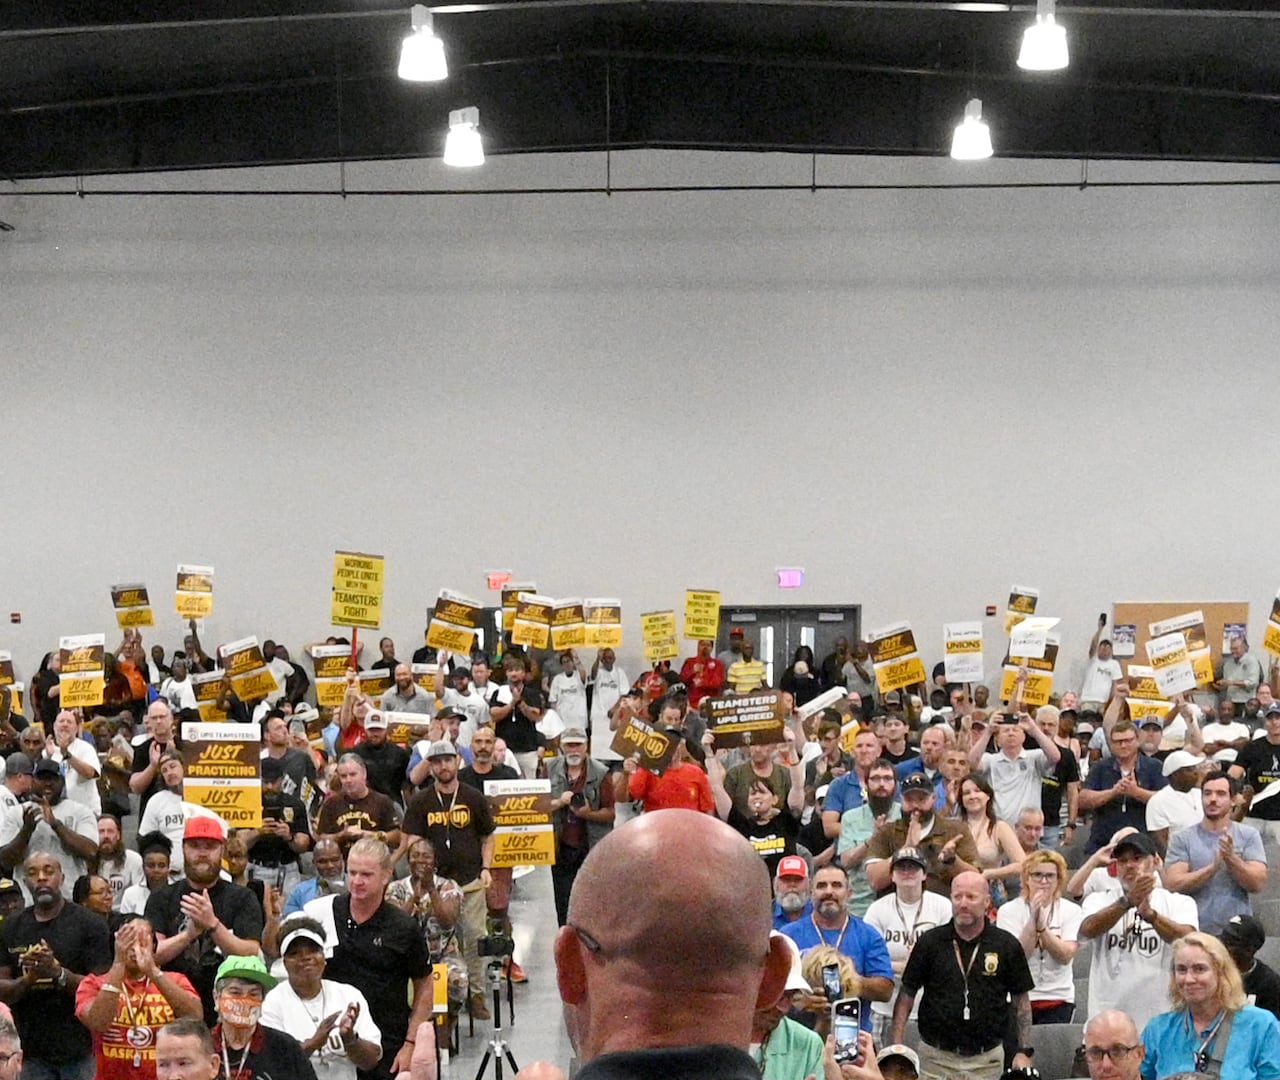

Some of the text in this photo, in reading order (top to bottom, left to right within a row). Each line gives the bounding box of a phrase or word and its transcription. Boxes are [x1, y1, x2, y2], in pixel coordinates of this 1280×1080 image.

[337, 570, 359, 579] PEOPLE
[335, 592, 379, 606] TEAMSTERS
[946, 640, 980, 650] UNIONS
[1152, 649, 1186, 665] UNIONS
[69, 680, 93, 690] JUST
[711, 695, 778, 709] TEAMSTERS
[717, 712, 774, 725] UPS GREED
[624, 726, 646, 747] pay
[200, 745, 244, 759] JUST
[188, 765, 256, 776] PRACTICING
[201, 790, 243, 804] JUST
[500, 797, 538, 810] JUST
[165, 813, 184, 826] pay
[427, 811, 467, 826] pay up
[492, 813, 549, 824] PRACTICING
[503, 835, 538, 848] JUST
[494, 852, 549, 862] CONTRACT
[1108, 932, 1158, 950] pay up
